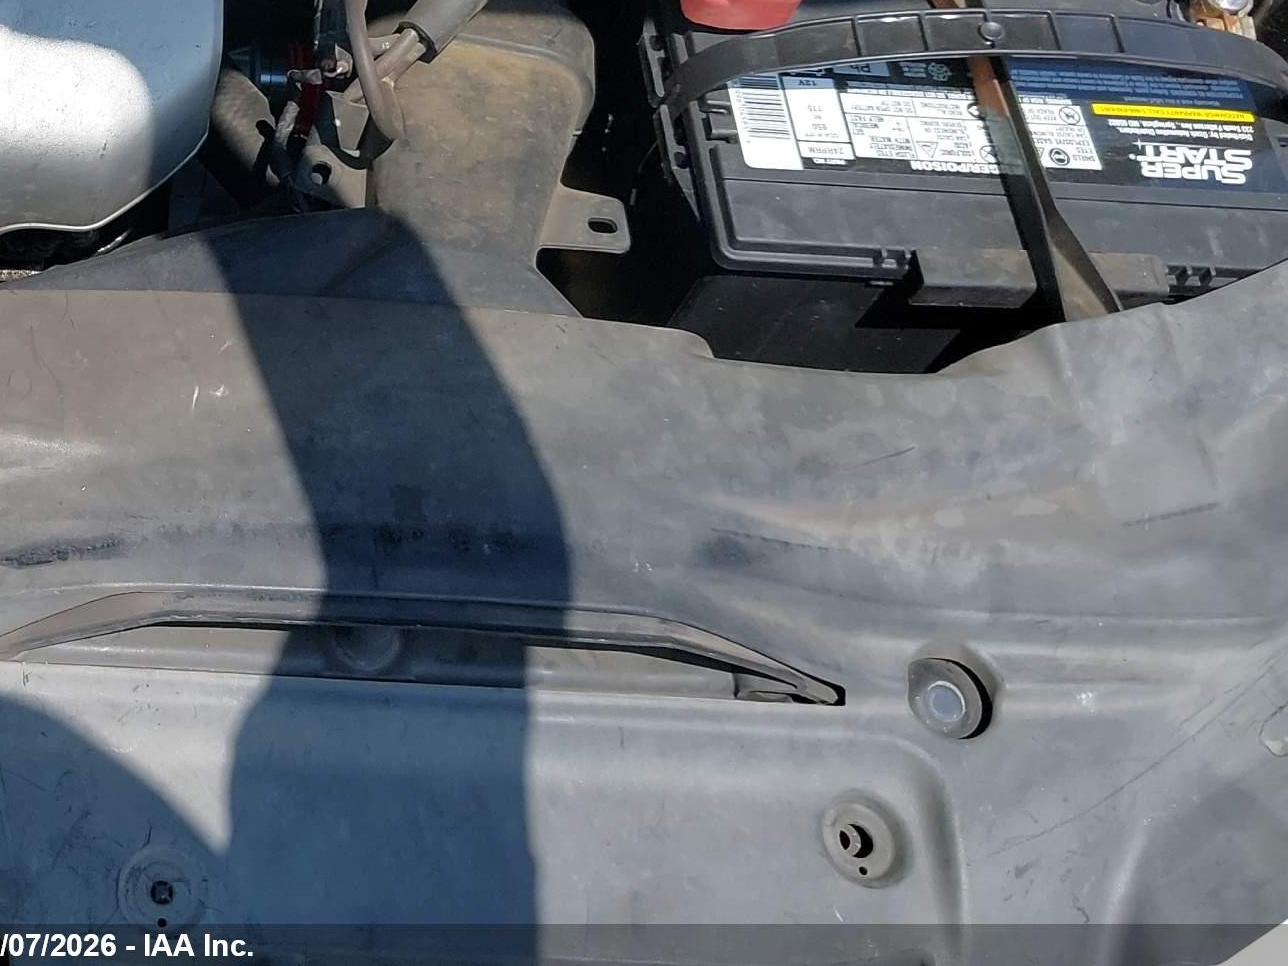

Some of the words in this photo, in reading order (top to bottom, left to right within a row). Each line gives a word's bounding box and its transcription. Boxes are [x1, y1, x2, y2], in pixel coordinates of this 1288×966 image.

[799, 79, 817, 87] 12V
[1135, 144, 1253, 172] START
[1140, 162, 1246, 185] SUPER
